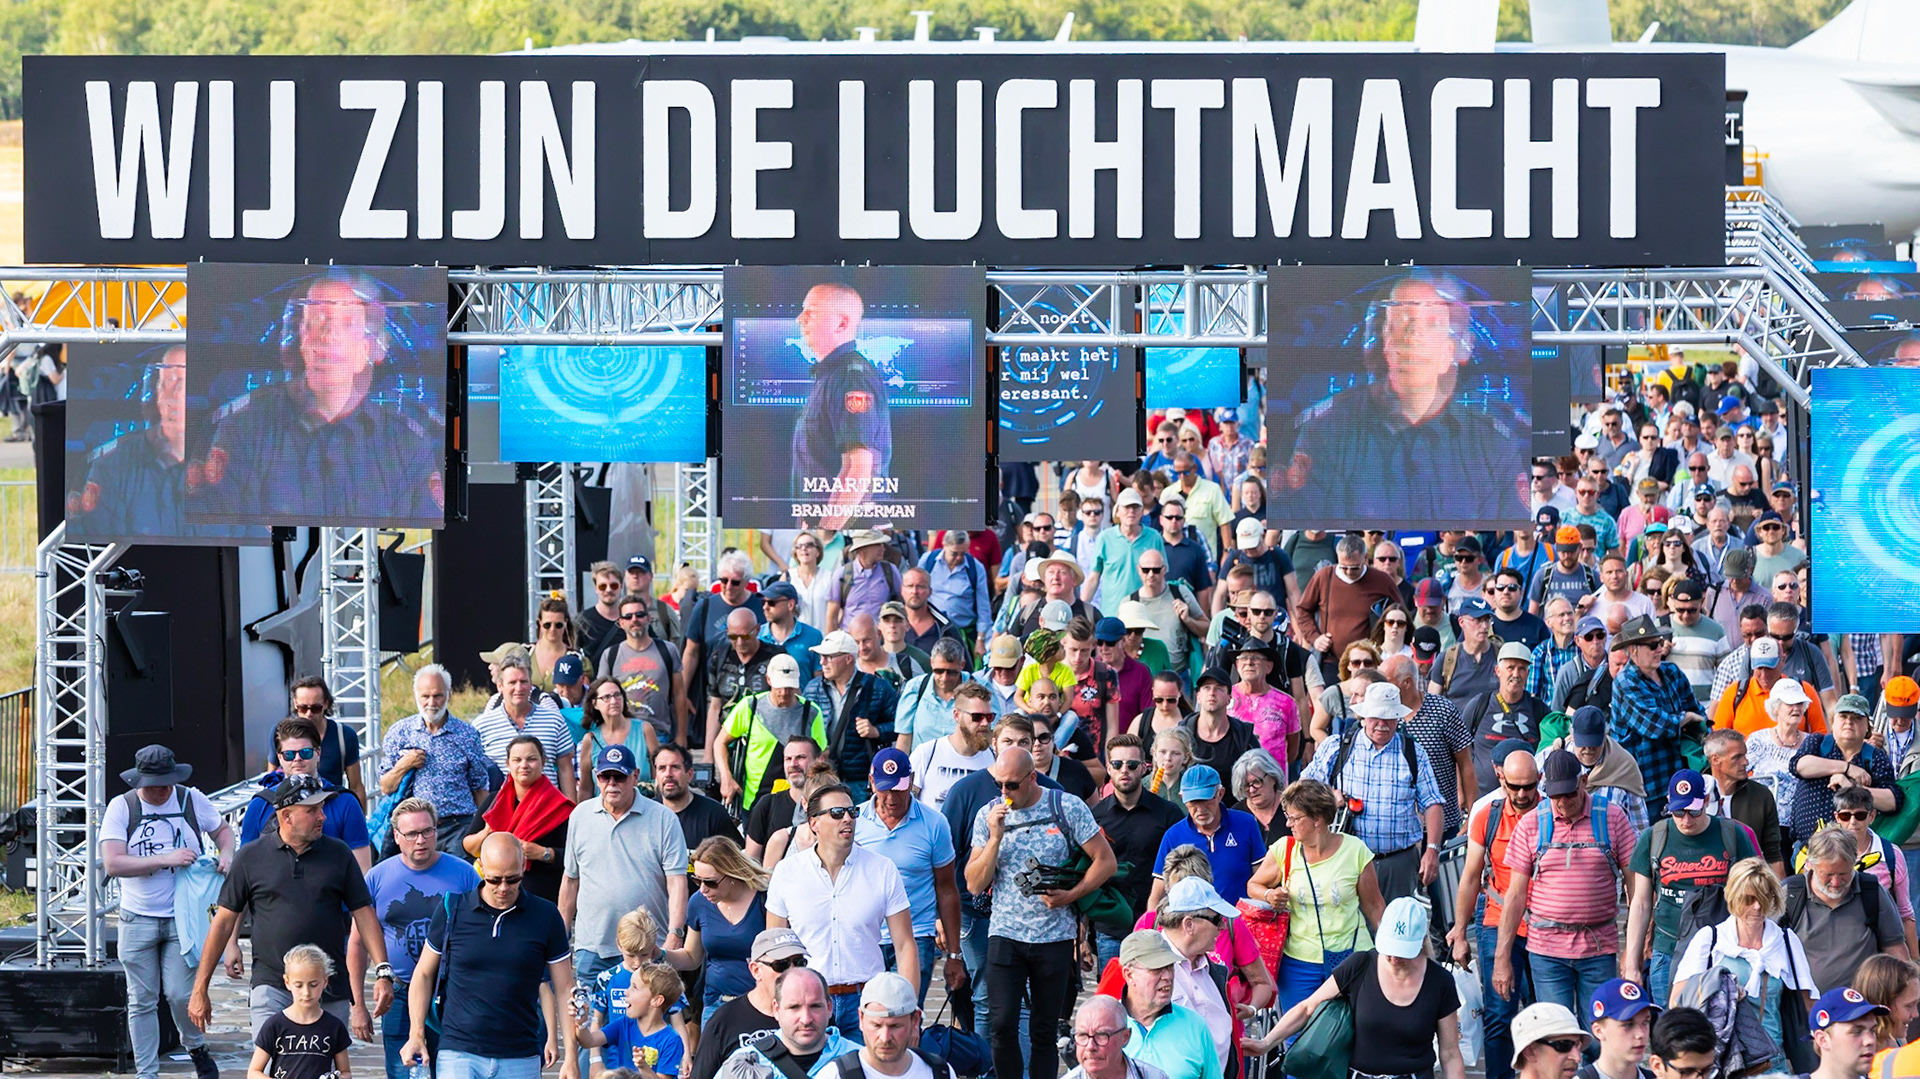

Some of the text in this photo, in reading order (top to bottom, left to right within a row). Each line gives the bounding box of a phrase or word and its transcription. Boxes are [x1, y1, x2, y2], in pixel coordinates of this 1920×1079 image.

[86, 78, 1660, 239] WIJ ZIJN DE LUCHTMACHT
[1020, 349, 1069, 364] maakt
[1080, 348, 1110, 364] het
[1020, 367, 1049, 386] mij
[1060, 367, 1090, 382] wel
[802, 477, 899, 494] MAARTEN
[791, 503, 916, 519] BRANDWEERMAN
[559, 662, 571, 675] NY
[1394, 921, 1406, 935] NY
[275, 1034, 331, 1055] STARS
